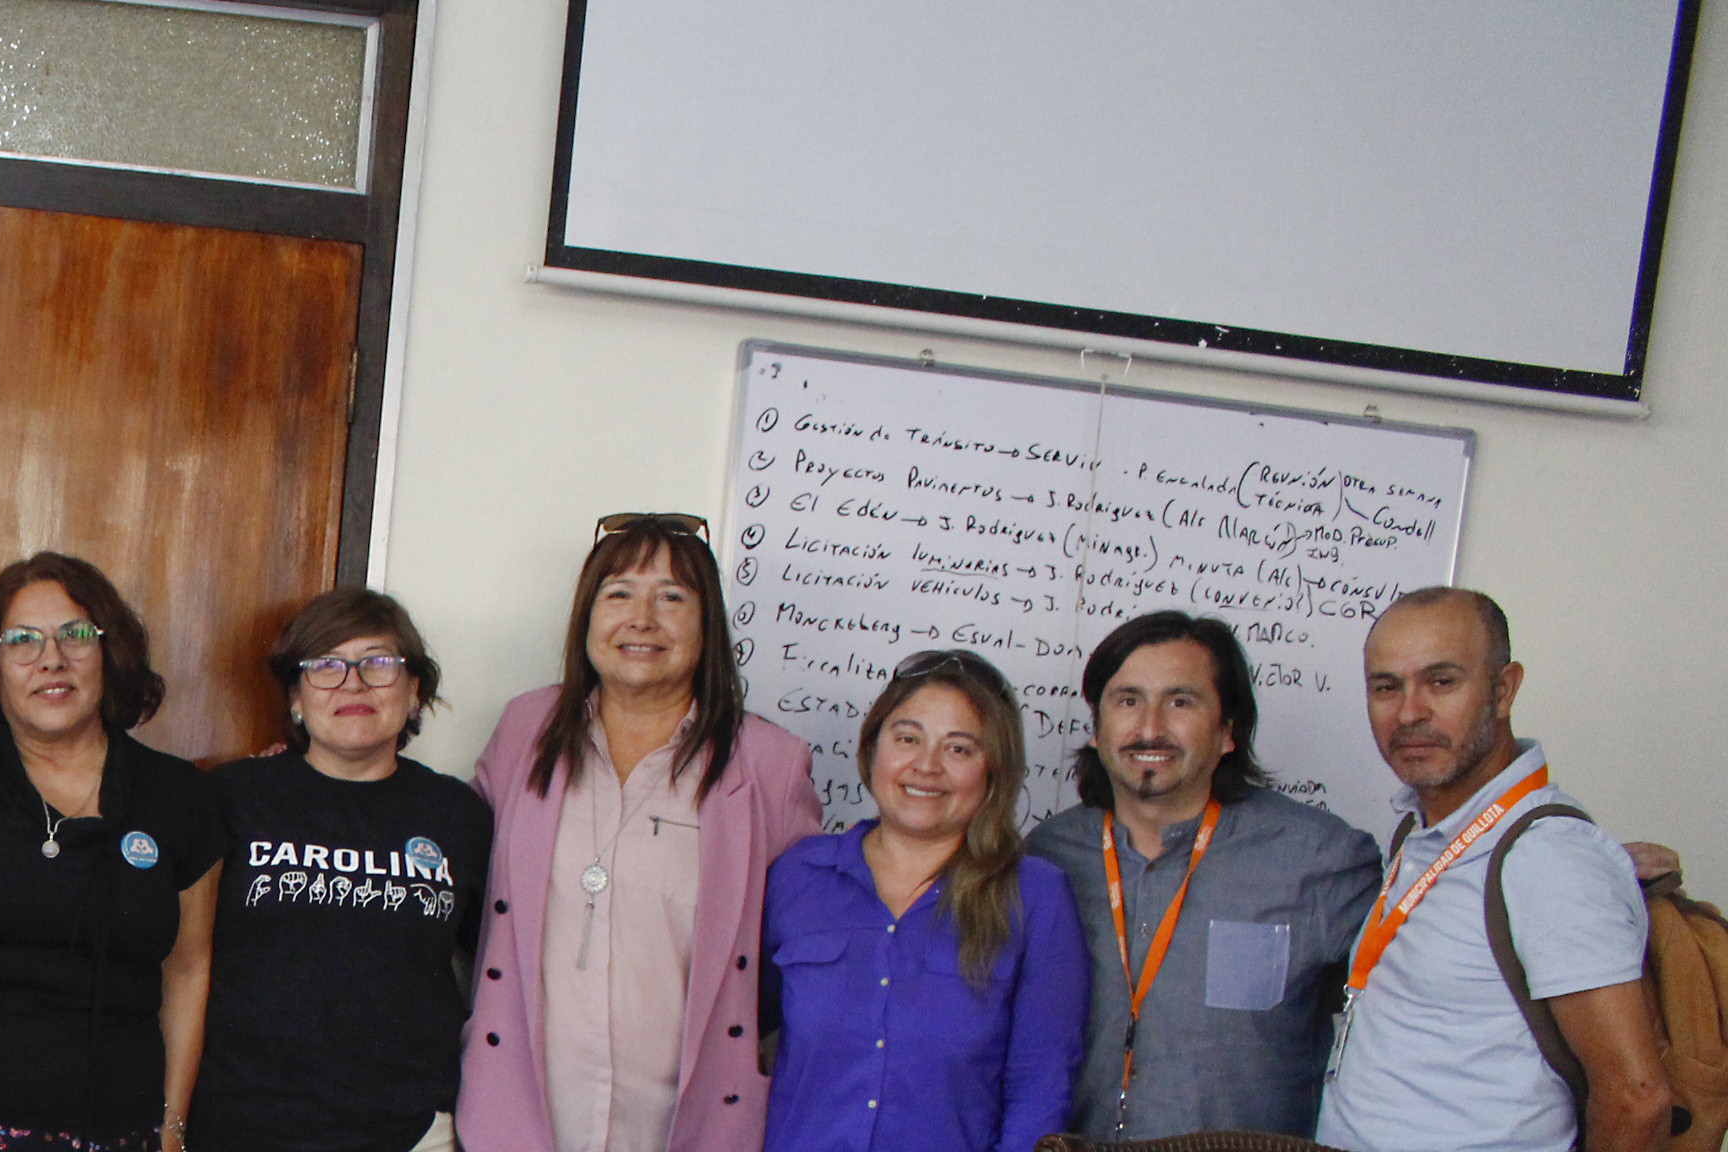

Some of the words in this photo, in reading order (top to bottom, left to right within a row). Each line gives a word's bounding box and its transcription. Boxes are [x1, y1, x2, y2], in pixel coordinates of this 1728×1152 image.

[248, 840, 454, 887] CAROLINA
[1398, 848, 1454, 915] MUNICIPALIDAD
[1450, 838, 1466, 855] DE
[1462, 803, 1505, 844] QUILLOTA
